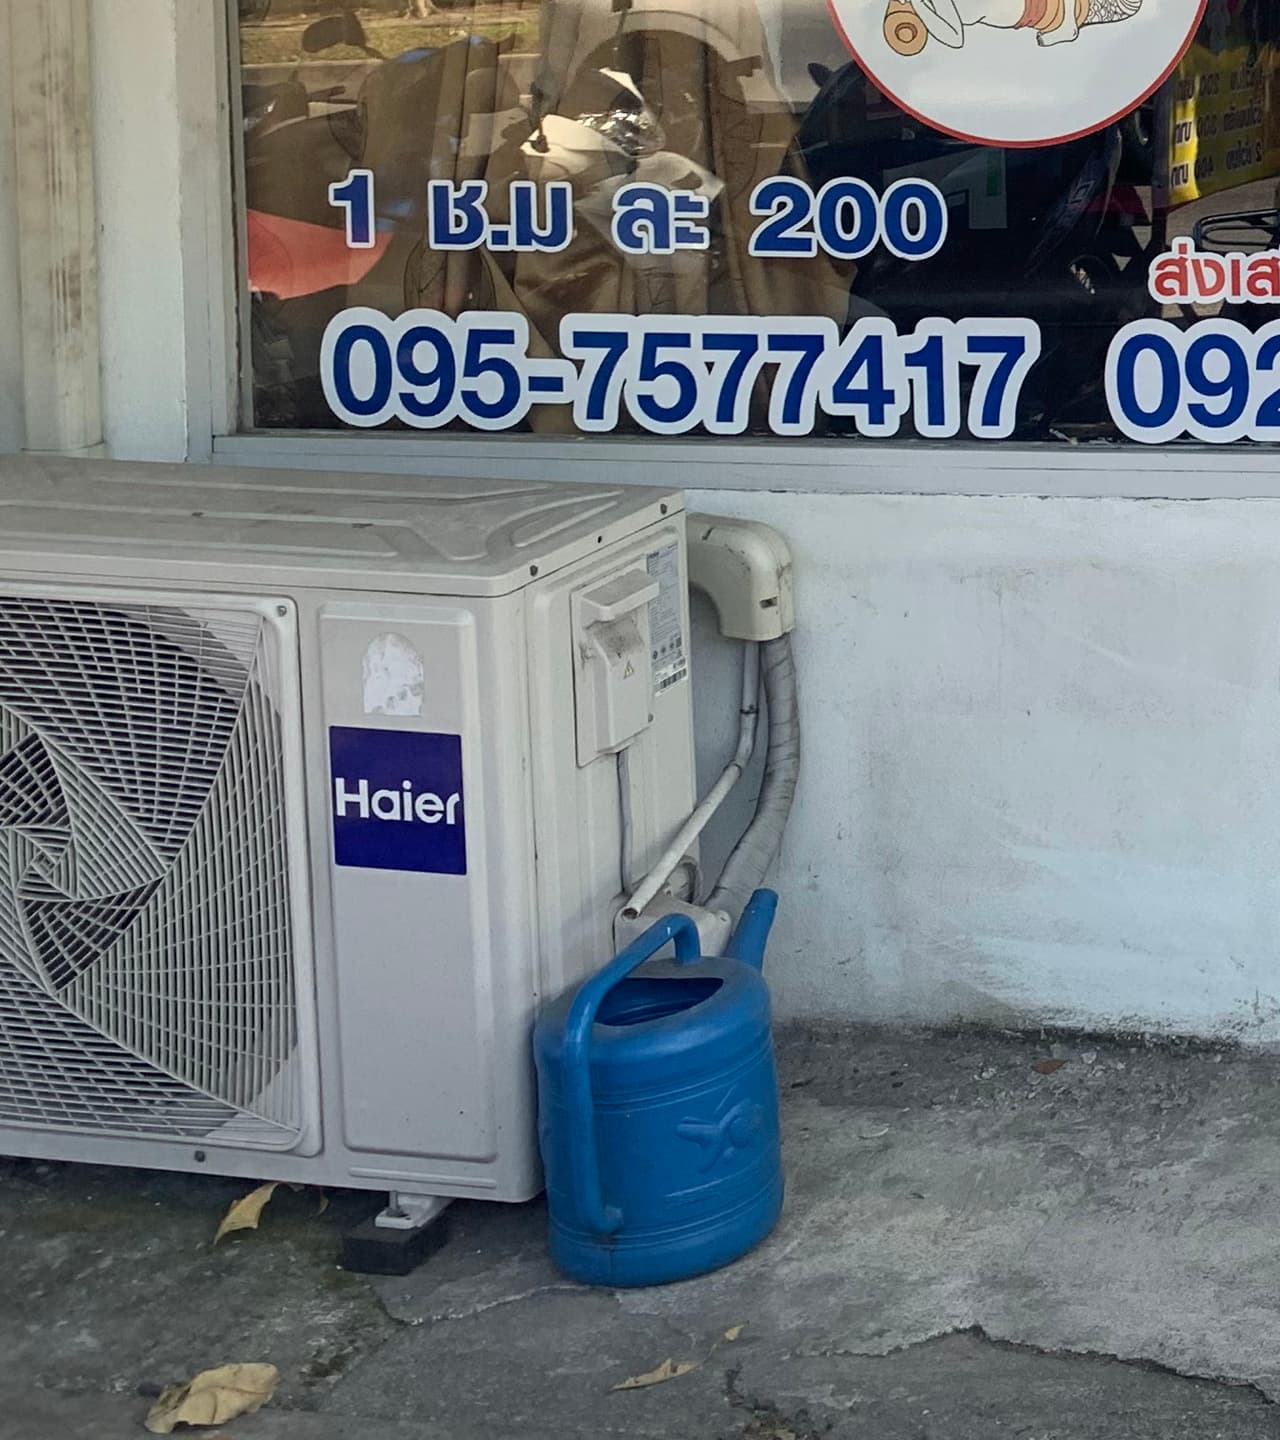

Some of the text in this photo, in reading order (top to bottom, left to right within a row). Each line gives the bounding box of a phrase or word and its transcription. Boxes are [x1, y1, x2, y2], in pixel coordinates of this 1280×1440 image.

[333, 174, 371, 244] 1
[616, 187, 706, 250] ละ
[753, 180, 943, 256] 200
[332, 325, 1026, 427] 095-7577417
[335, 776, 460, 826] Haier
